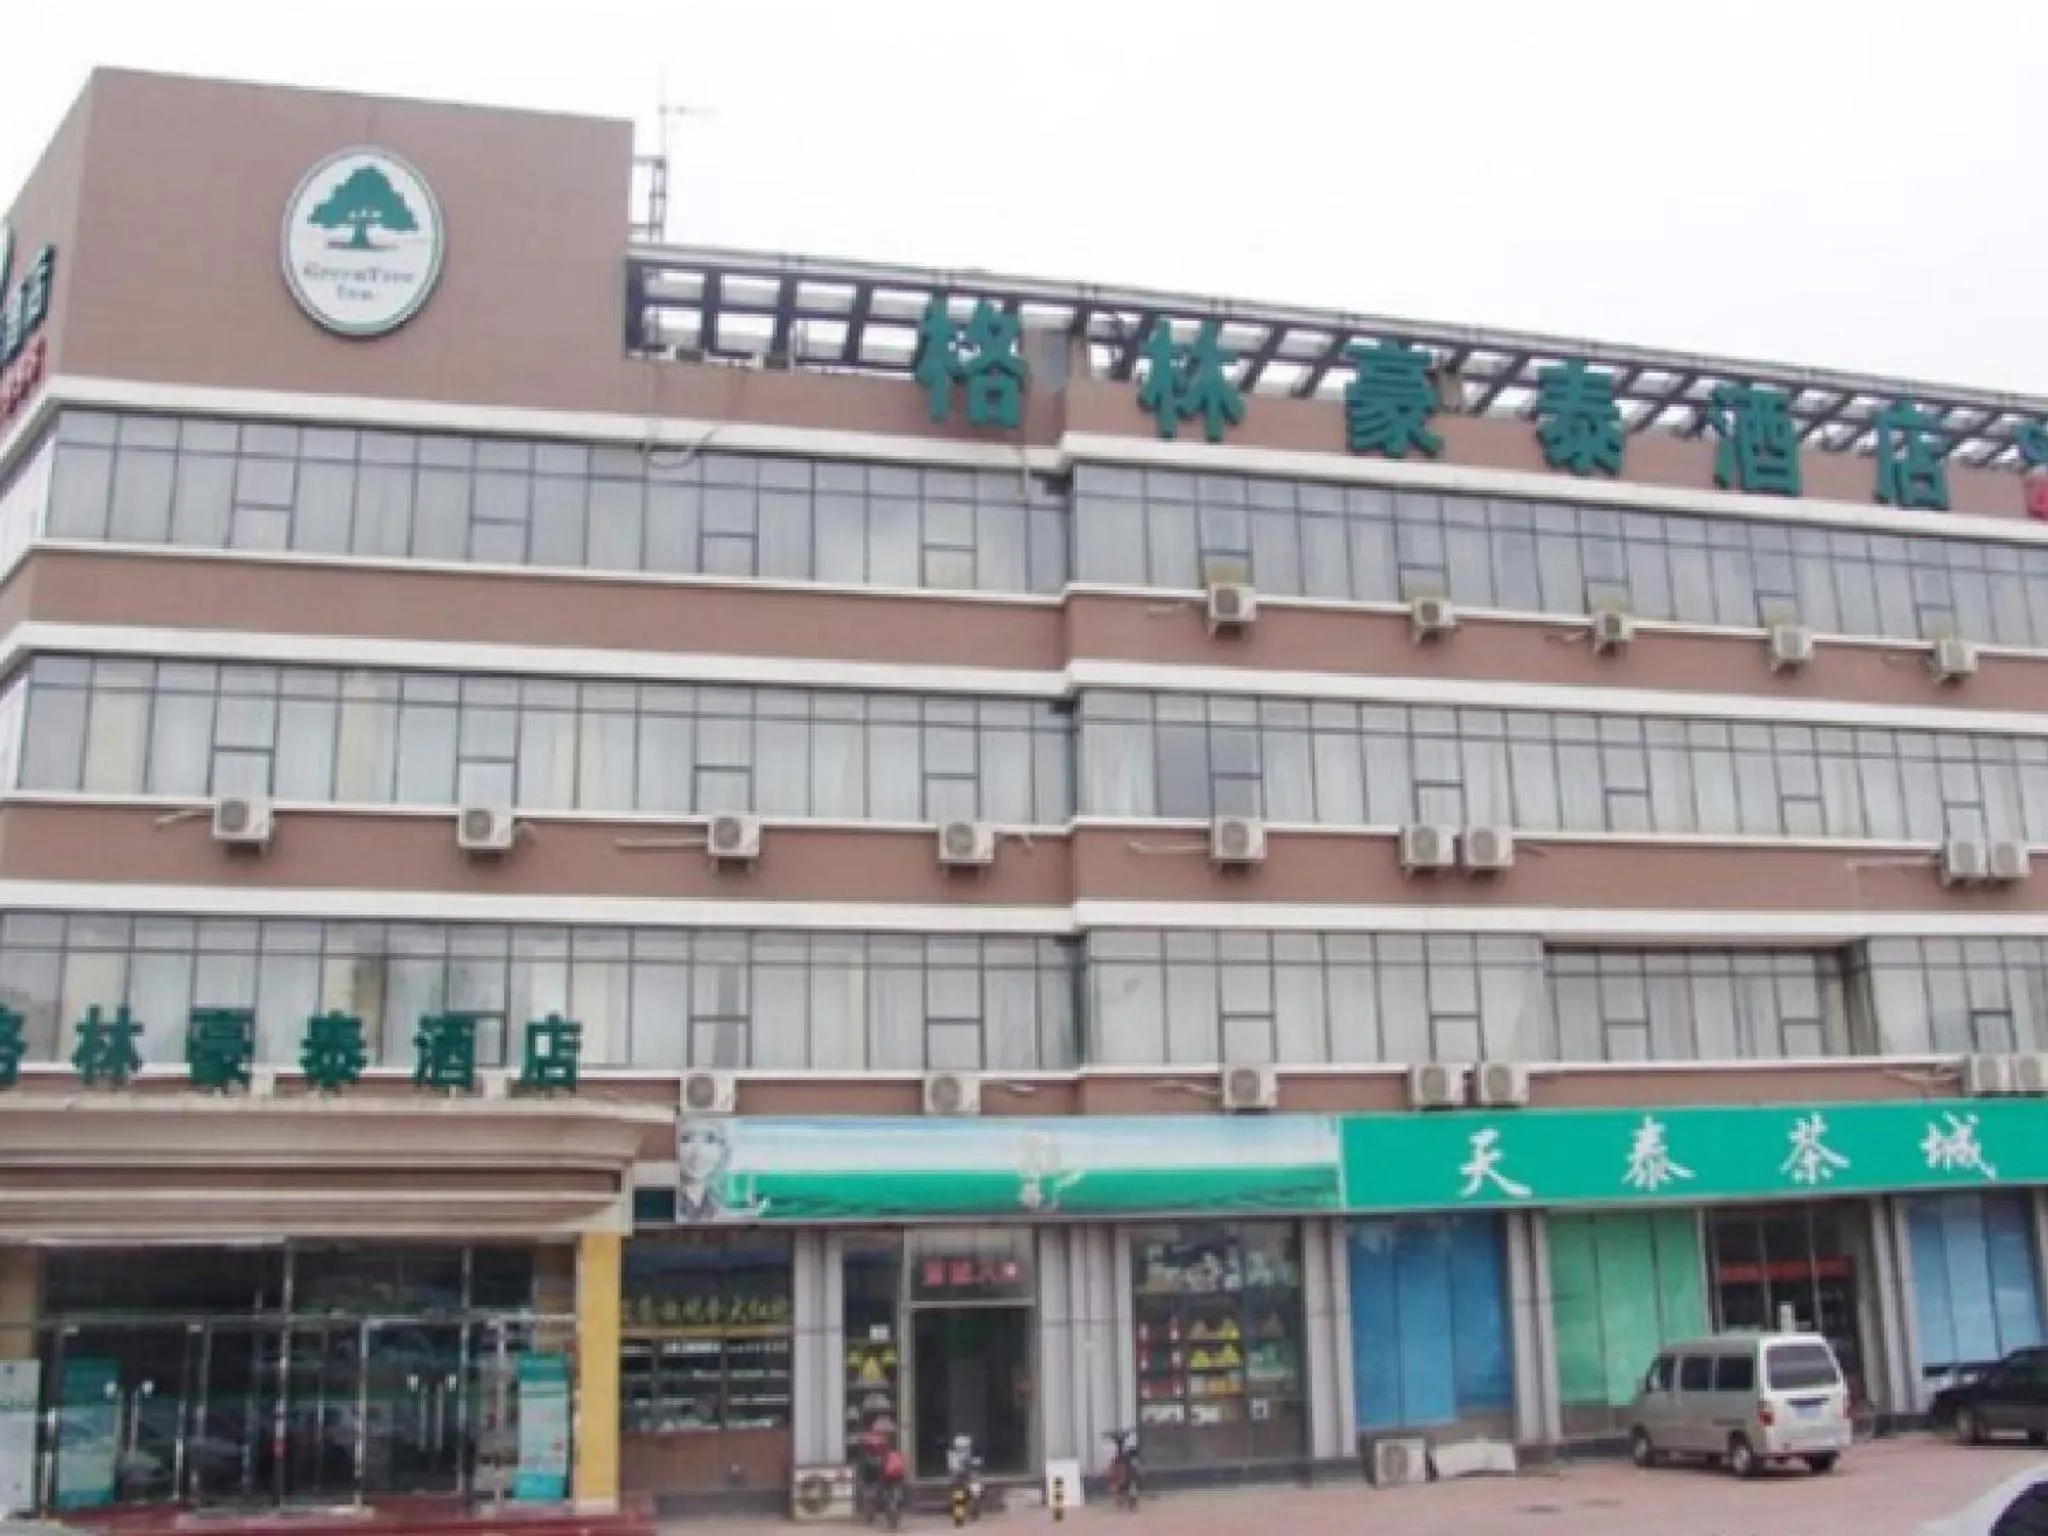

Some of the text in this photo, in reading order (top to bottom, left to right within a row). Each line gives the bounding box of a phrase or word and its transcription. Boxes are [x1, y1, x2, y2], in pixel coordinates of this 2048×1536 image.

[913, 295, 1951, 511] 格林豪泰酒店
[1460, 1112, 1997, 1199] 天泰茶城
